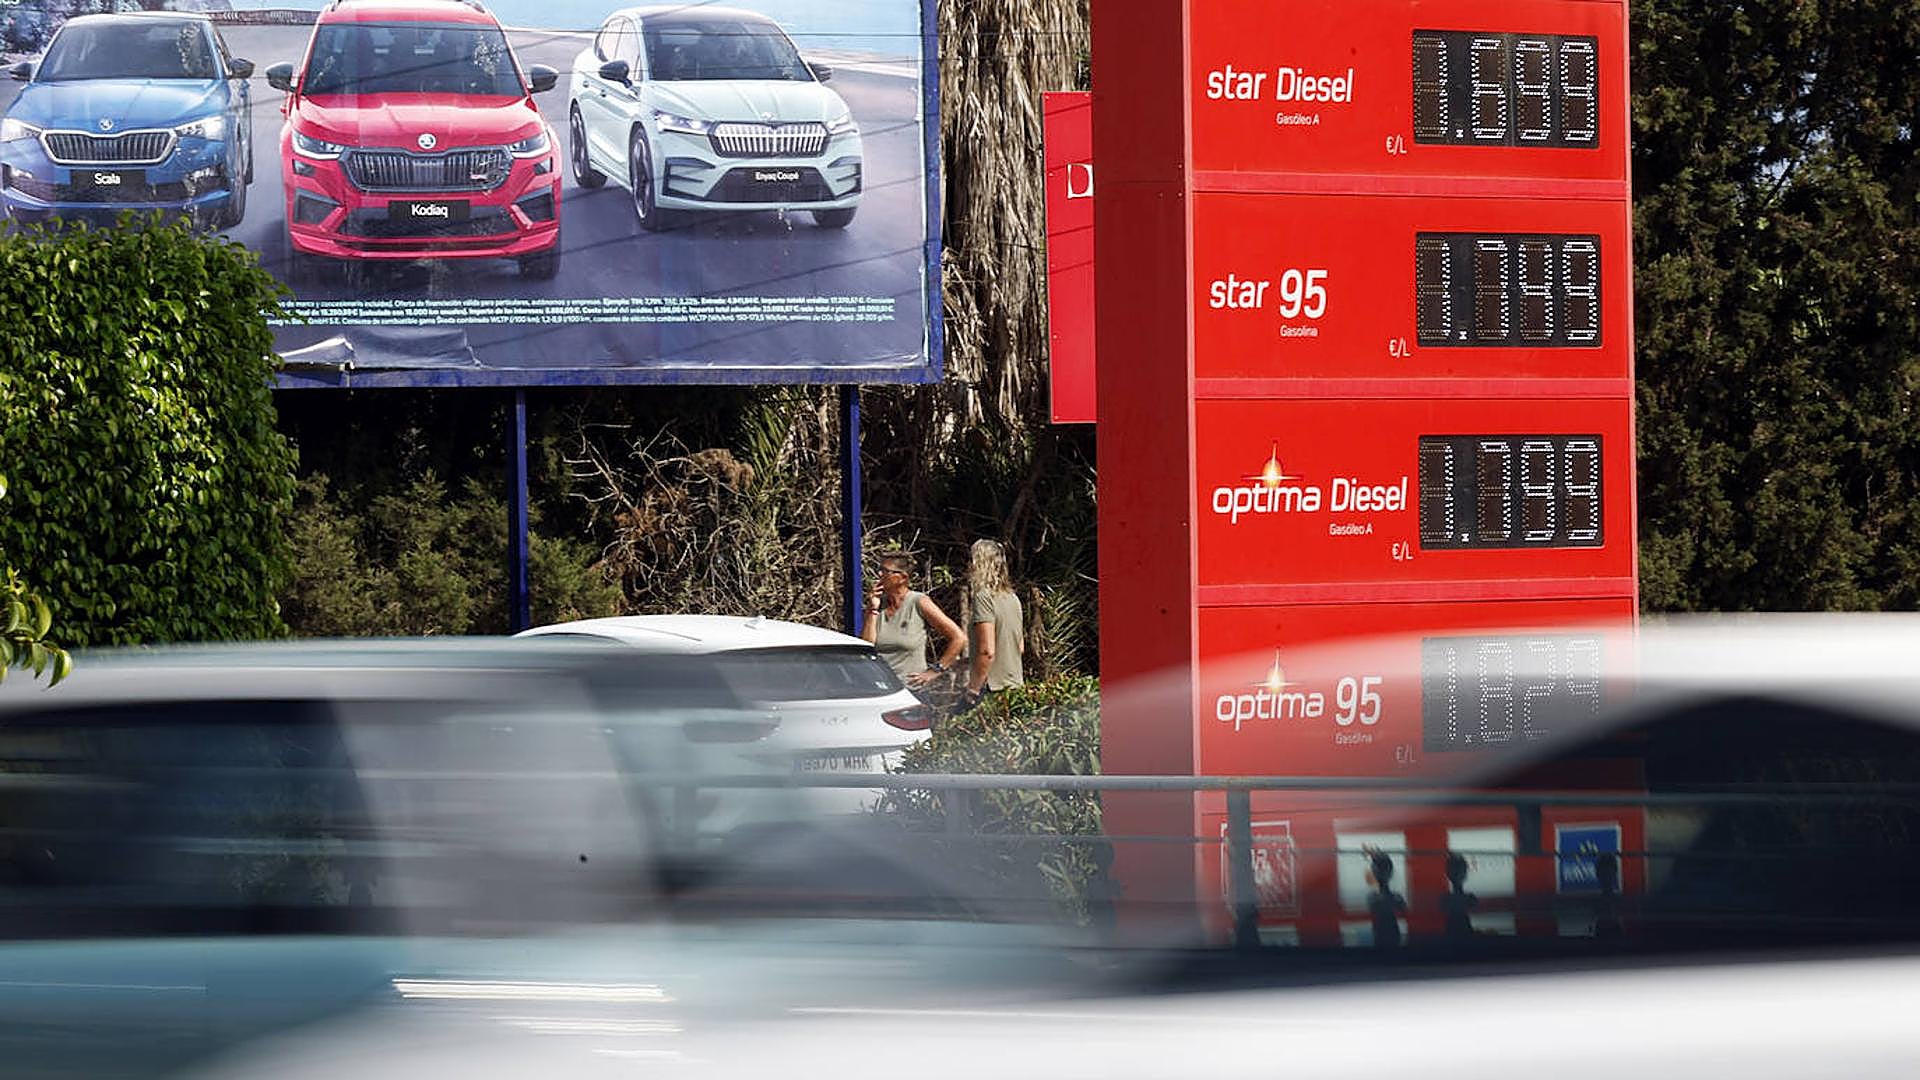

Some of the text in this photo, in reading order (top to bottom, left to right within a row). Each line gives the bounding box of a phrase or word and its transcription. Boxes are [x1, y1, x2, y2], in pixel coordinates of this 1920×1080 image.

[1206, 64, 1354, 103] star Diesel
[1437, 37, 1596, 141] 1.699
[1276, 112, 1320, 126] Gasóleo A
[1386, 134, 1407, 155] €/L
[94, 172, 121, 185] Scala
[411, 203, 448, 219] Kodiaq
[1209, 268, 1328, 320] star 95
[1441, 239, 1598, 342] 1.749
[1279, 324, 1318, 338] Gasolina
[1389, 336, 1411, 358] €/L
[1212, 477, 1408, 524] optima Diesel
[1444, 440, 1598, 542] 1.799
[1329, 523, 1373, 536] Gasóleo A
[1392, 542, 1413, 561] €/L
[1216, 676, 1383, 732] optima 95
[1335, 732, 1373, 745] Gasolina
[1396, 744, 1416, 764] €/L
